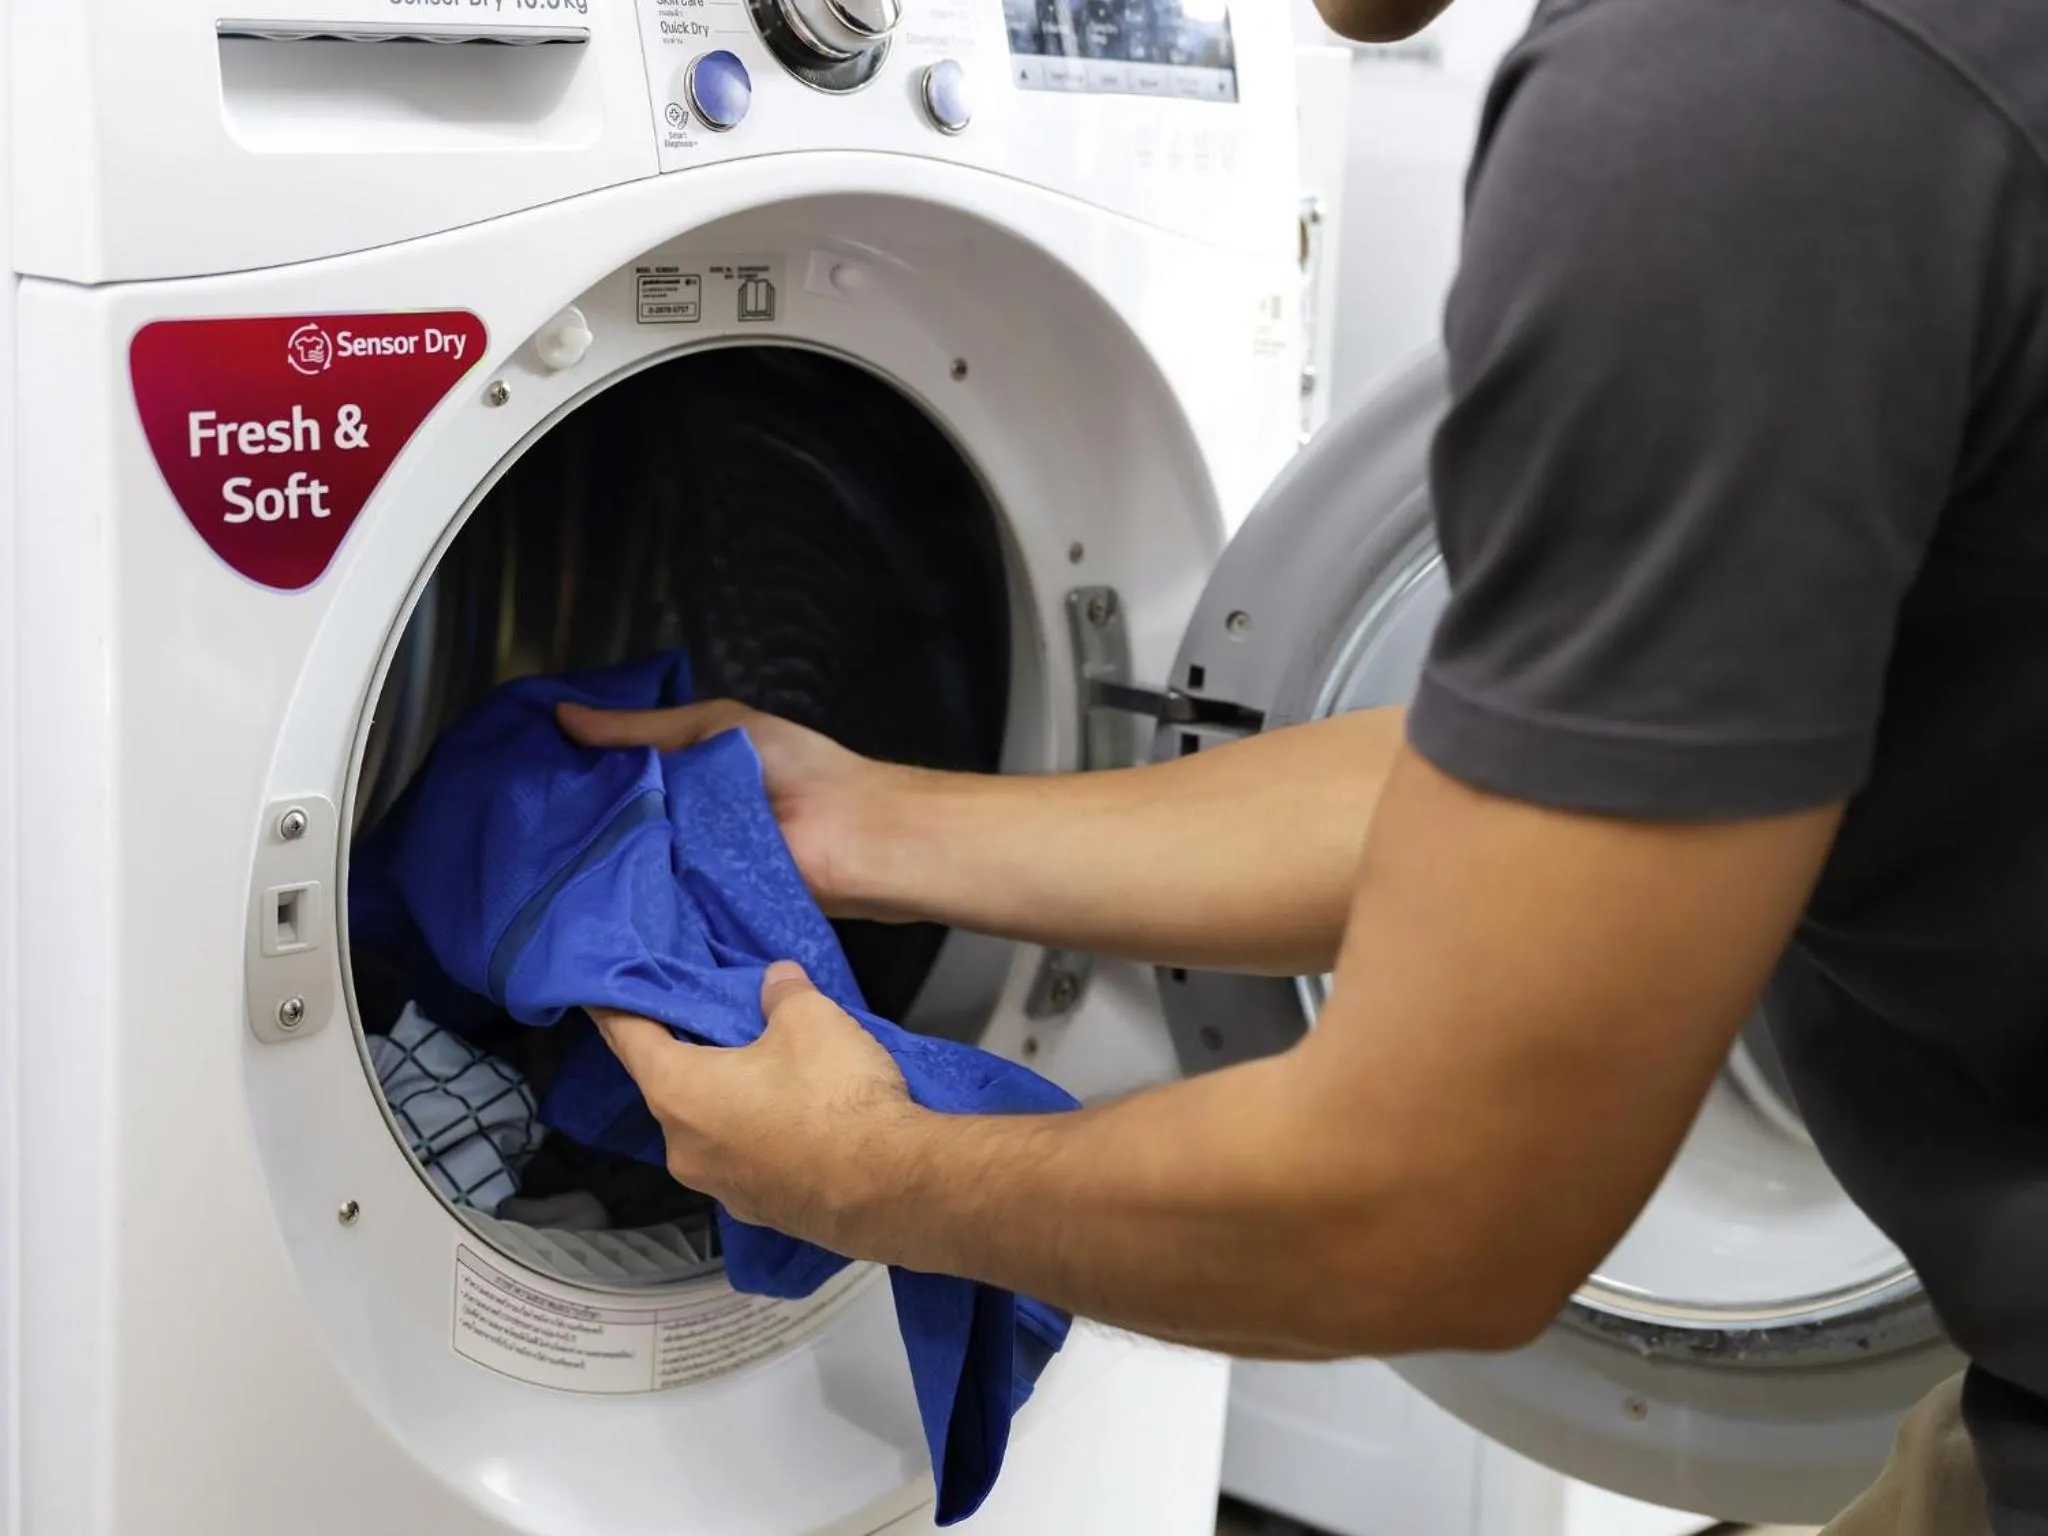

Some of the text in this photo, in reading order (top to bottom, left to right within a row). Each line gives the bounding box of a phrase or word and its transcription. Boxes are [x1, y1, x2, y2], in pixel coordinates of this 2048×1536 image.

[660, 20, 710, 38] Quick Dry
[336, 328, 468, 360] Sensor Dry
[187, 403, 371, 458] Fresh &
[221, 471, 332, 524] Soft
